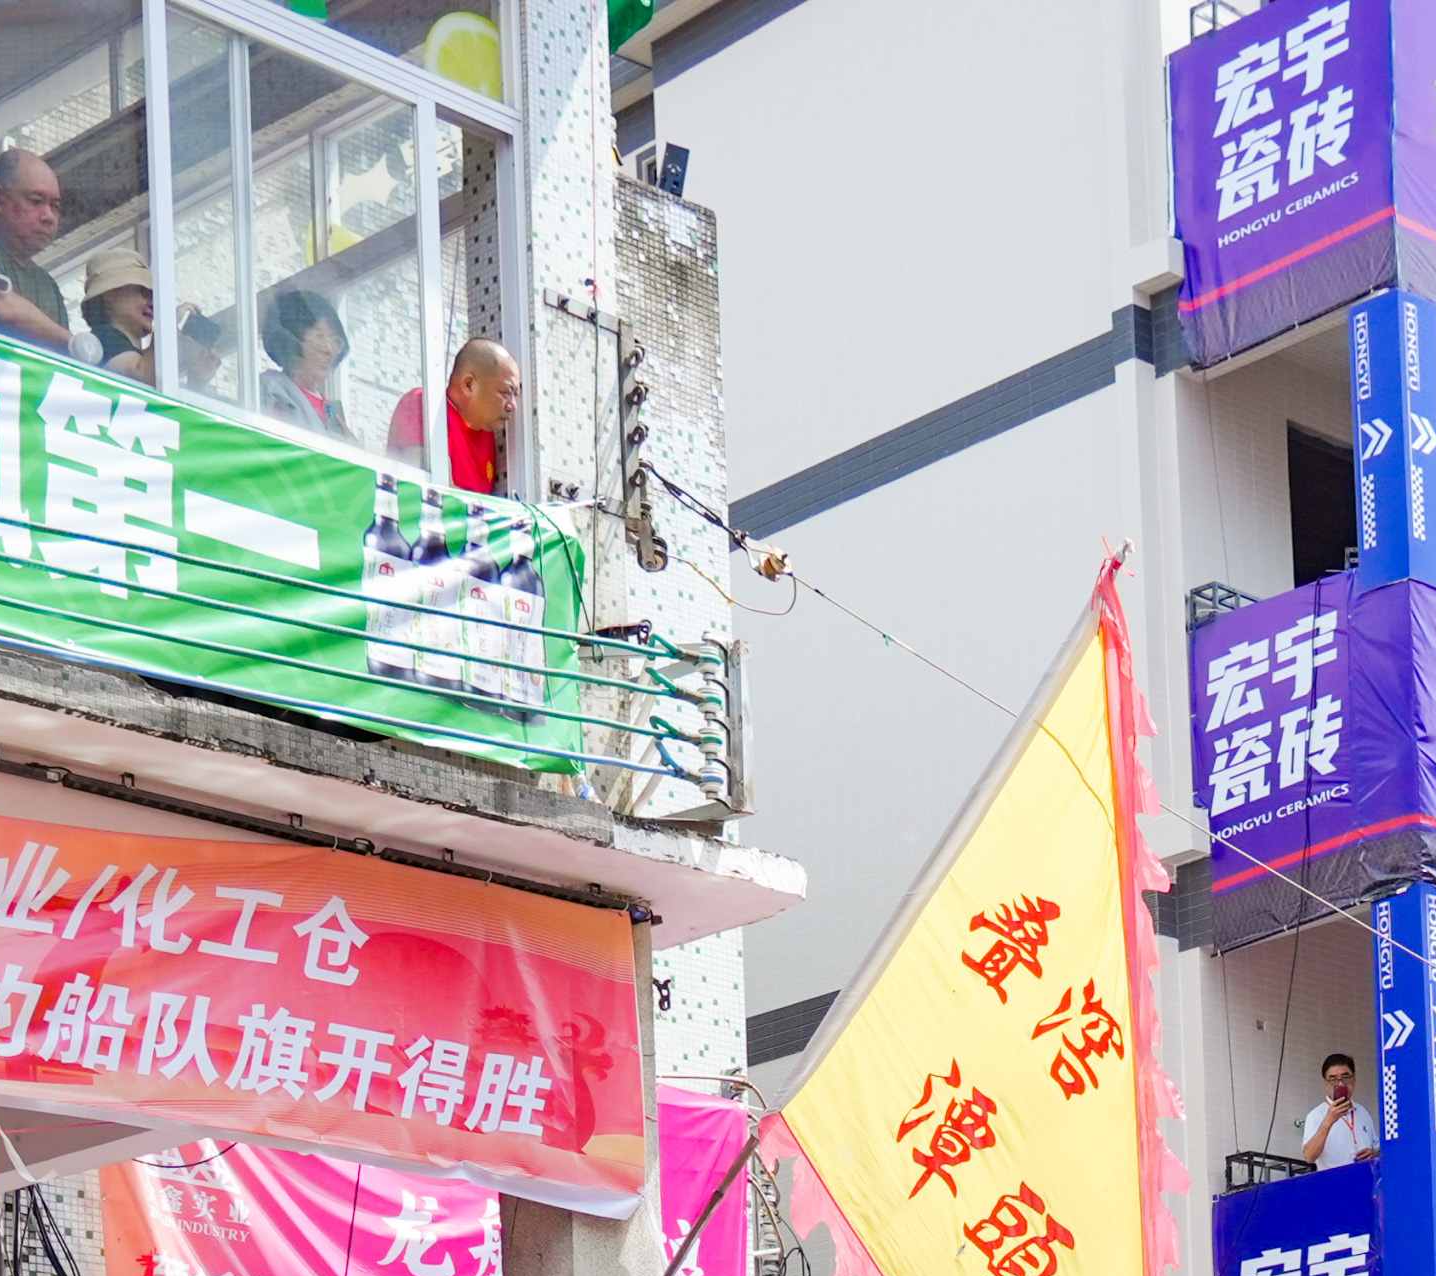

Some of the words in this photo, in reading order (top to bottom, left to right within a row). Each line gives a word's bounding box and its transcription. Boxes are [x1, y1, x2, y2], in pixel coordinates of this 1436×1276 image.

[1213, 0, 1352, 139] 宏宇
[1215, 84, 1355, 223] 瓷砖
[1217, 207, 1282, 249] HONGYU
[1284, 171, 1360, 218] CERAMICS
[1353, 311, 1369, 401] HONGYU
[1403, 302, 1419, 392] HONGYU
[1203, 608, 1339, 733] 宏宇
[1207, 695, 1343, 818] 瓷砖
[1275, 782, 1350, 823] CERAMICS
